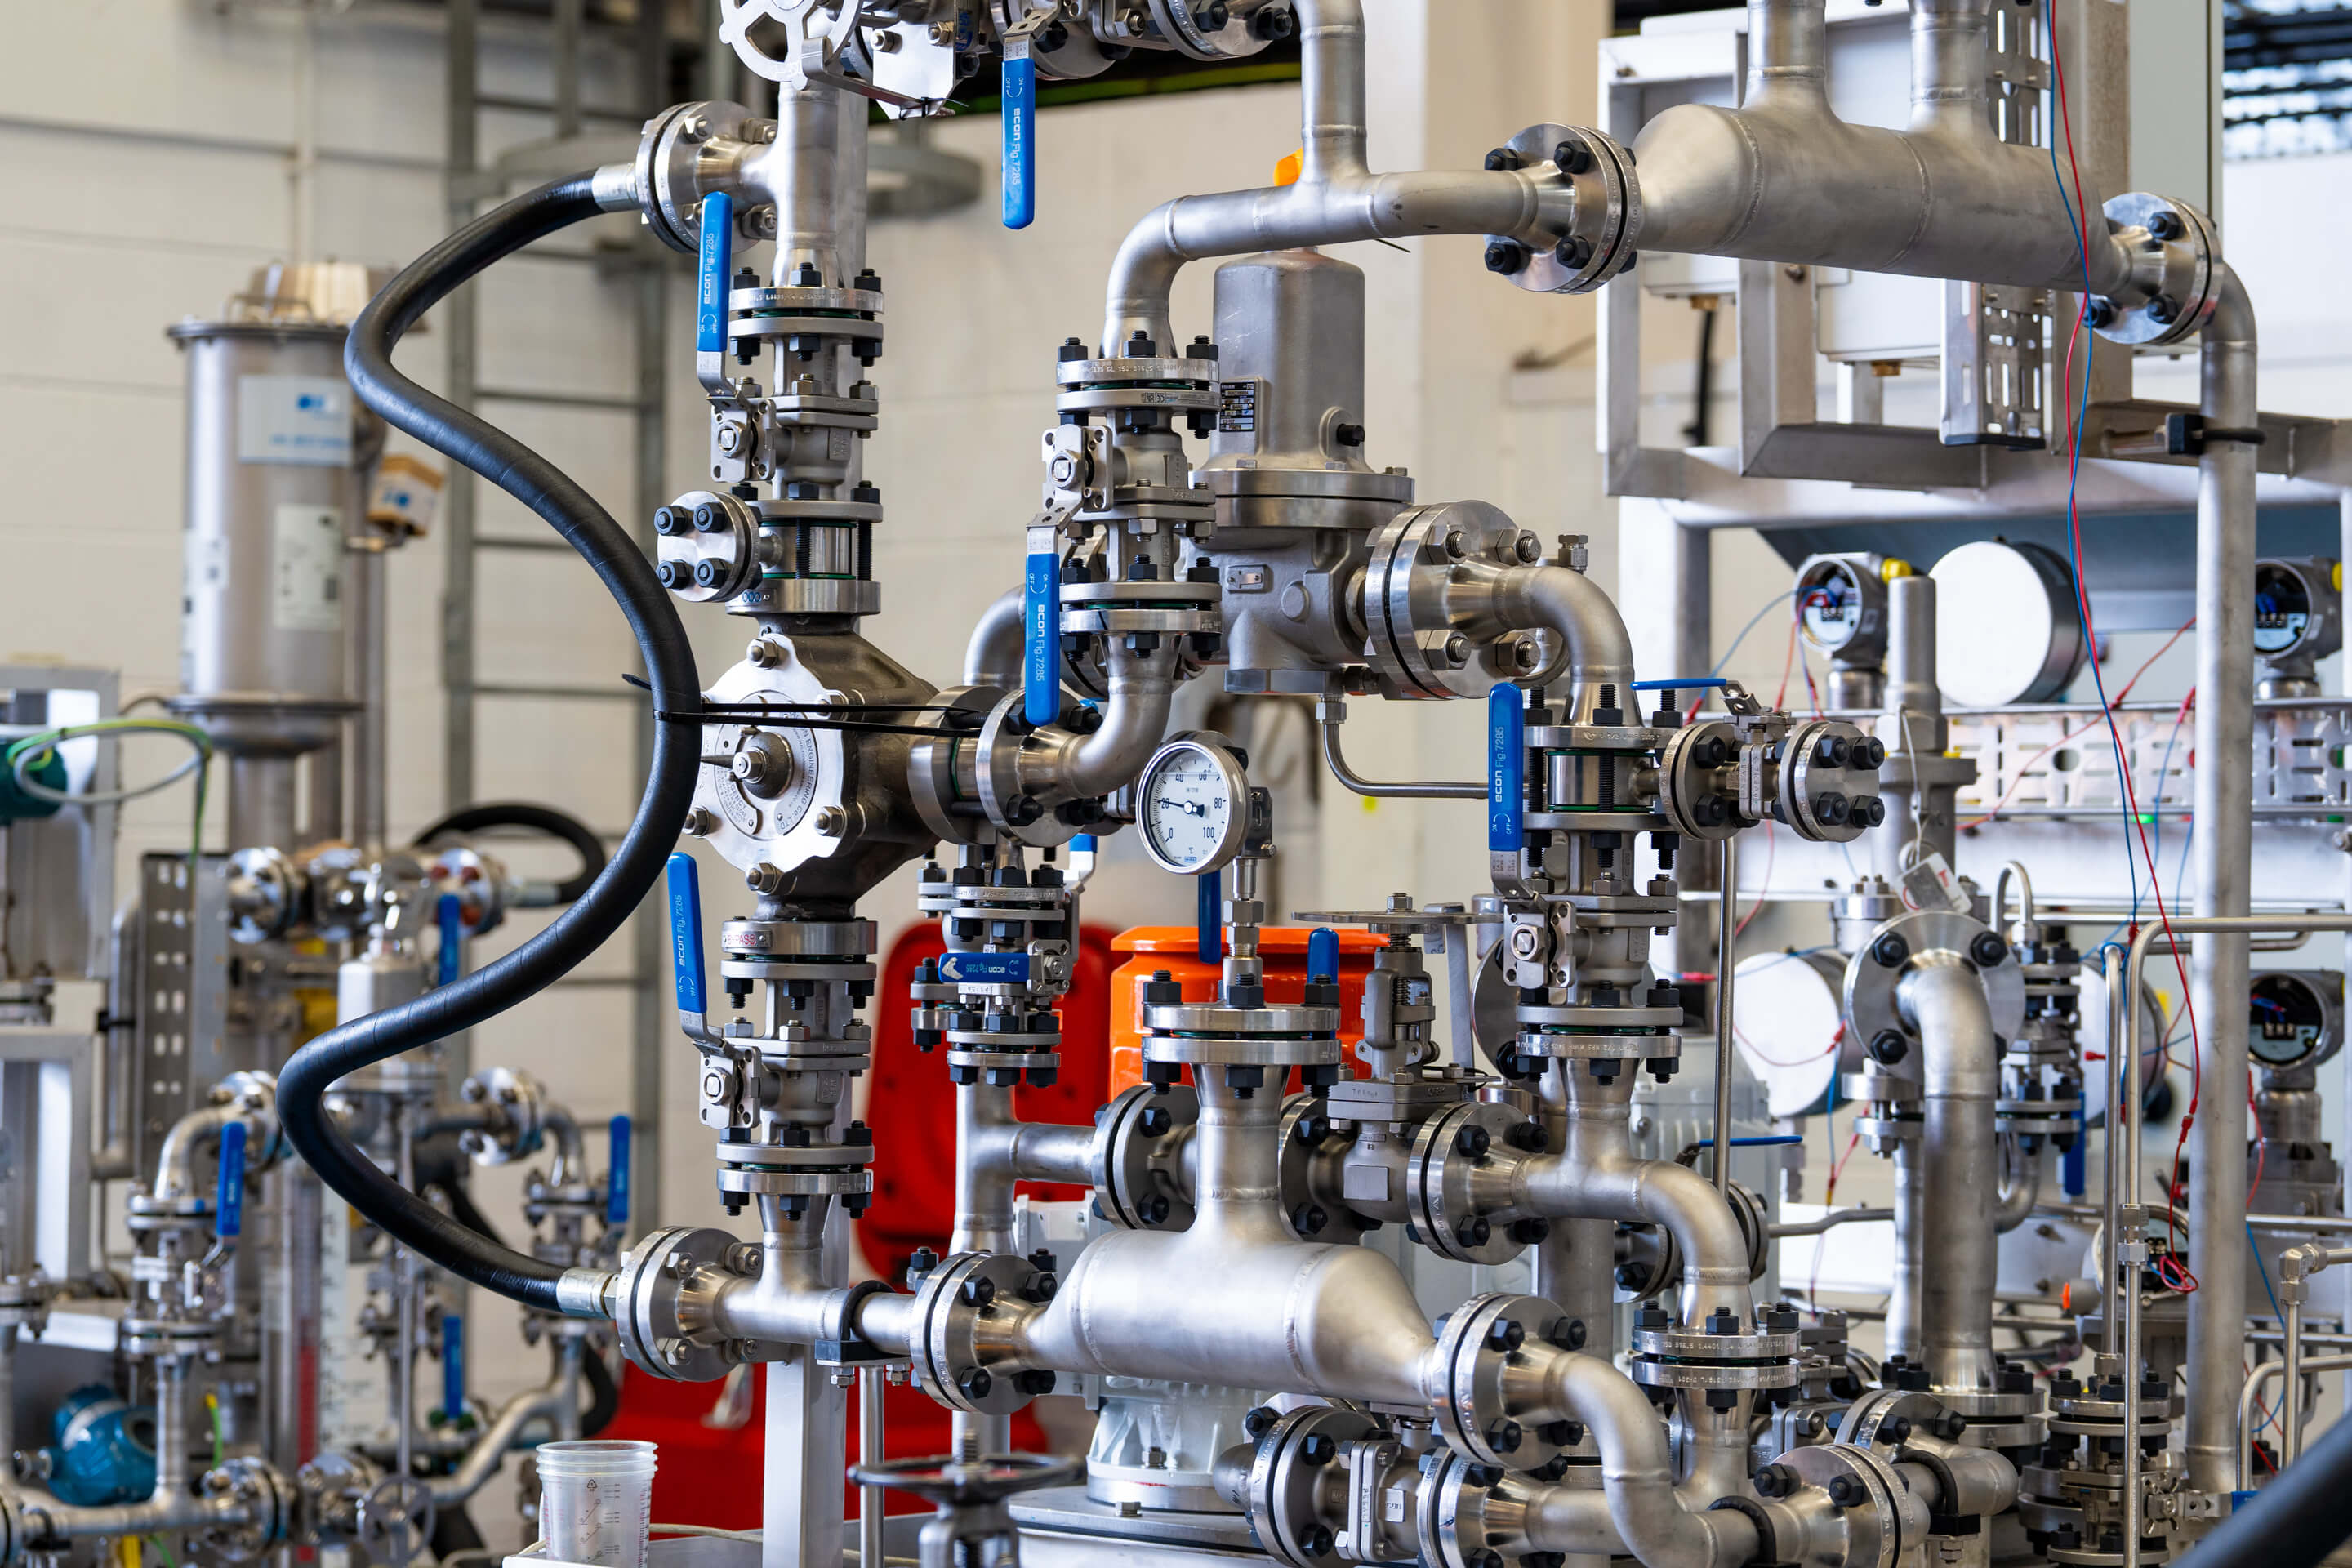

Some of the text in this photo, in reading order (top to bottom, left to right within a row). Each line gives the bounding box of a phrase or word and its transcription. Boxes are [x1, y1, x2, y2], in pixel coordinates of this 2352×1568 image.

[703, 274, 711, 305] econ
[1042, 573, 1048, 582] ON
[1037, 604, 1045, 638] econ
[1214, 797, 1223, 808] 80
[1169, 827, 1174, 839] 0
[1203, 826, 1215, 838] 100
[676, 935, 685, 967] econ
